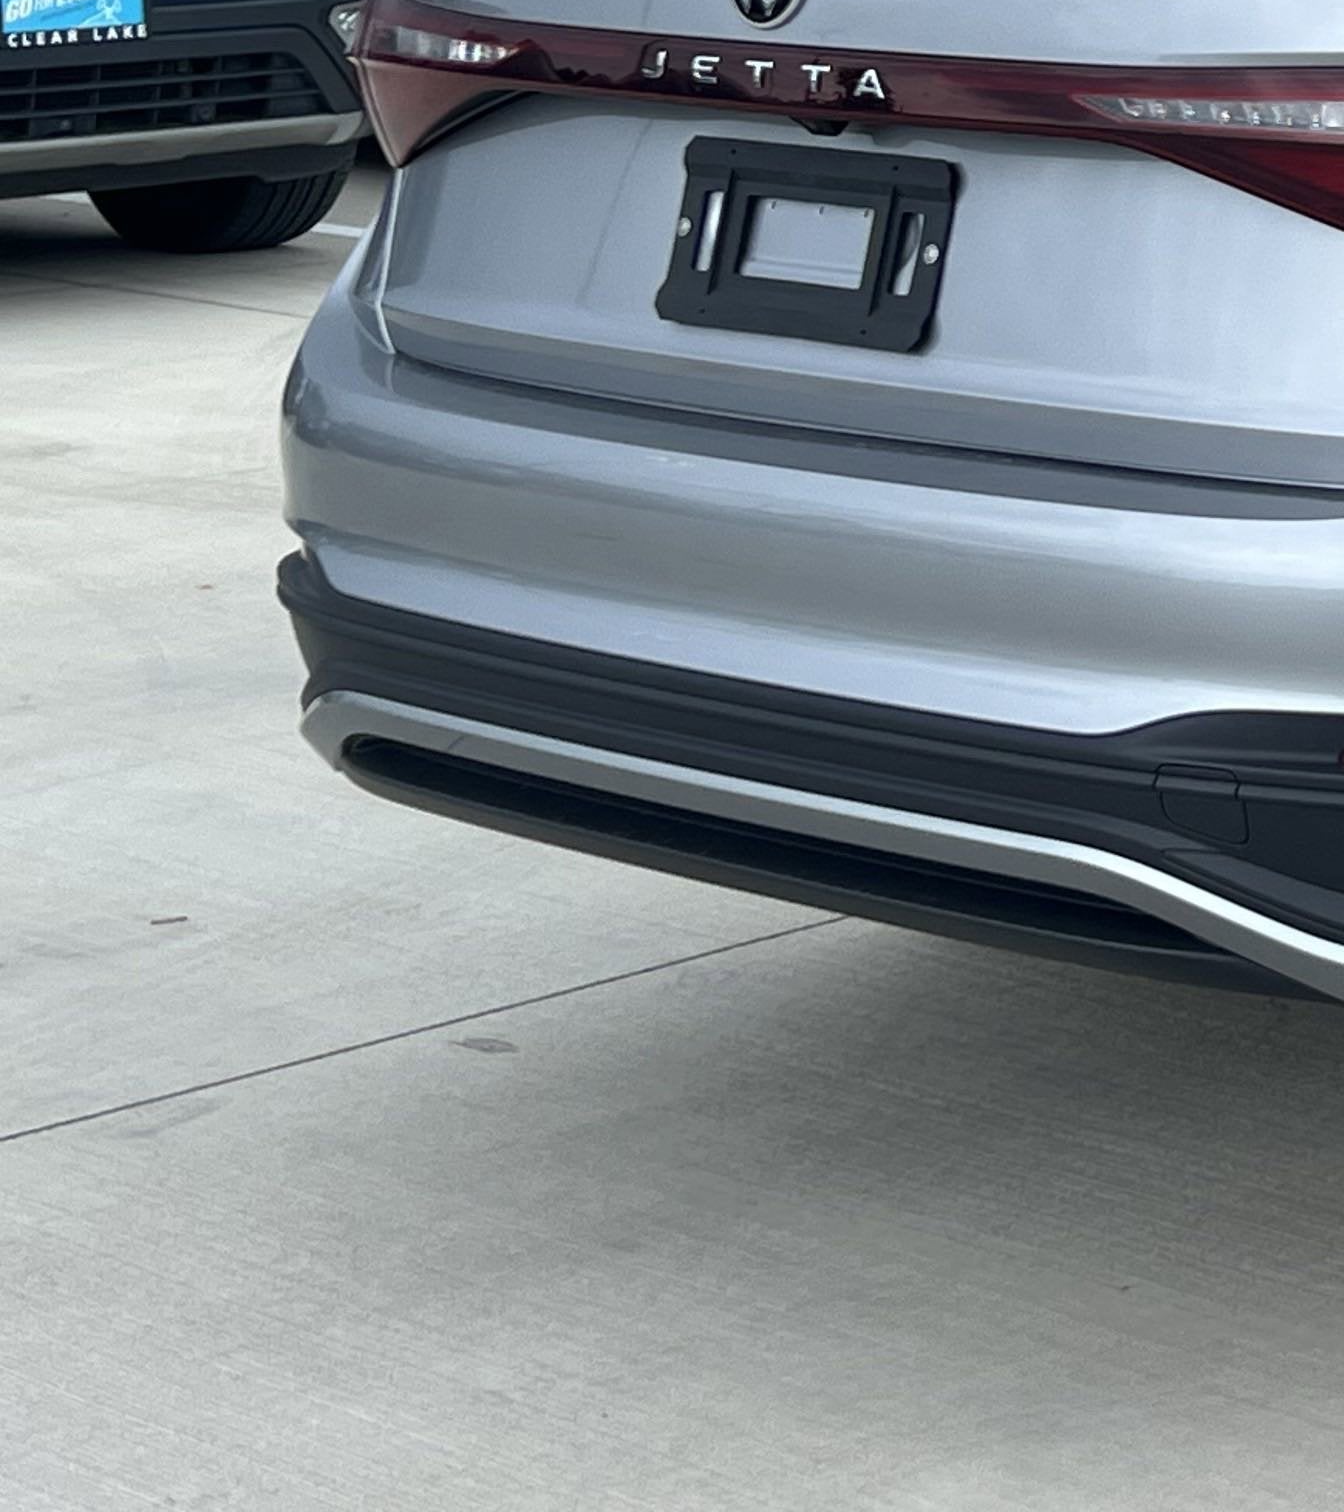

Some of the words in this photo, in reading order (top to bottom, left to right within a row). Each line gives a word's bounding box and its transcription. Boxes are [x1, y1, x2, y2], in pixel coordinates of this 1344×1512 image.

[7, 28, 79, 48] CLEAR
[92, 23, 148, 42] LAKE
[641, 50, 886, 101] JETTA
